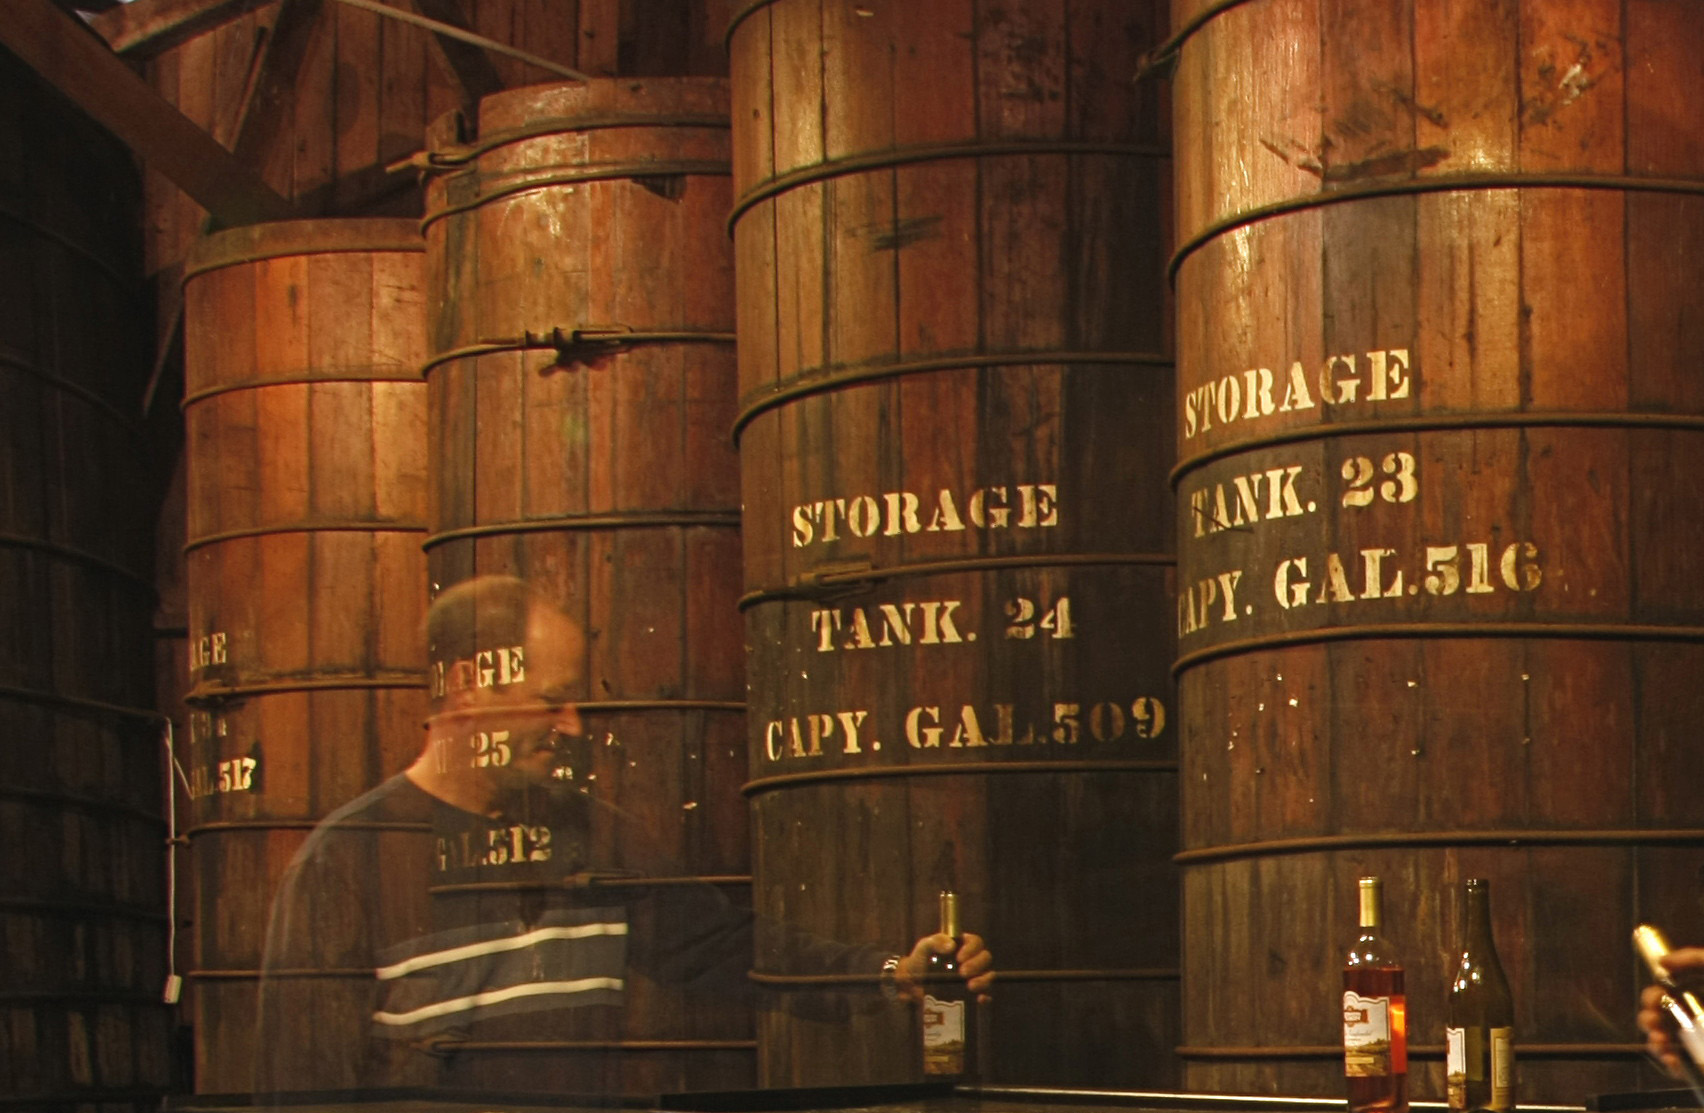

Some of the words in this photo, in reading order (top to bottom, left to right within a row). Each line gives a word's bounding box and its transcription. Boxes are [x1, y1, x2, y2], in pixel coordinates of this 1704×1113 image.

[1184, 348, 1411, 440] STORAGE
[791, 484, 1058, 548] STORAGE
[1191, 465, 1318, 539] TANK.
[1340, 451, 1419, 509] 23
[1273, 541, 1543, 611] GAL.516
[811, 600, 978, 653] TANK.
[1004, 596, 1076, 641] 24
[470, 730, 511, 769] 25
[764, 710, 882, 762] CAPY.
[904, 696, 1167, 750] GAL.509
